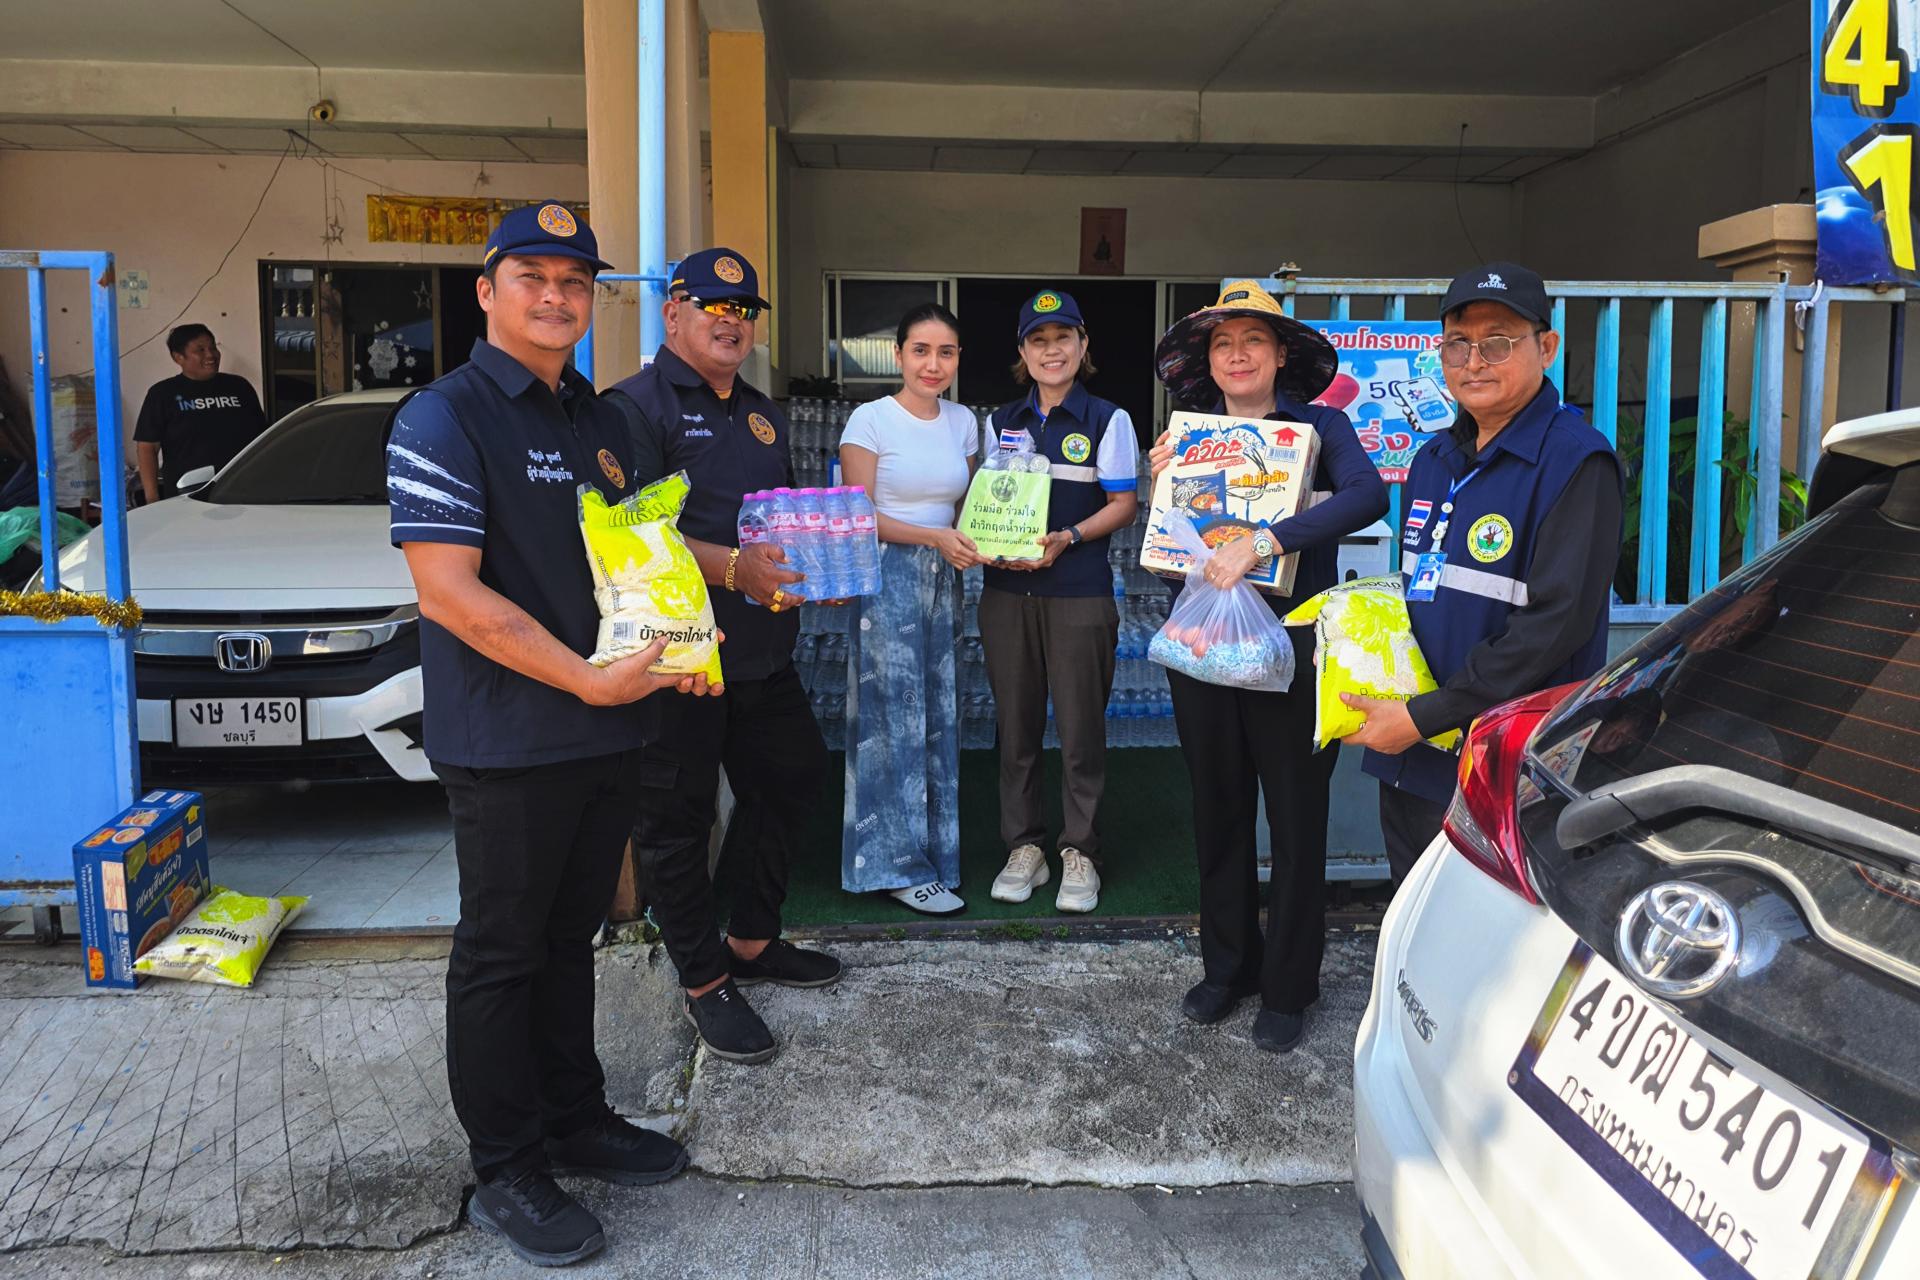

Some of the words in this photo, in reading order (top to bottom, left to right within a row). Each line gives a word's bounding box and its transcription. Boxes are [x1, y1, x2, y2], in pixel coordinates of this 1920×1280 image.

[1320, 327, 1444, 349] ่วมโครงการ
[1358, 419, 1411, 451] รึ่ง
[189, 702, 224, 725] งษ
[240, 701, 297, 724] 1450
[223, 729, 256, 745] ชลบุรี
[176, 926, 250, 945] ข้าวตราไก่แจ้
[1678, 1050, 1848, 1232] 5401
[1558, 1075, 1759, 1267] กรงเทพมหานคร
